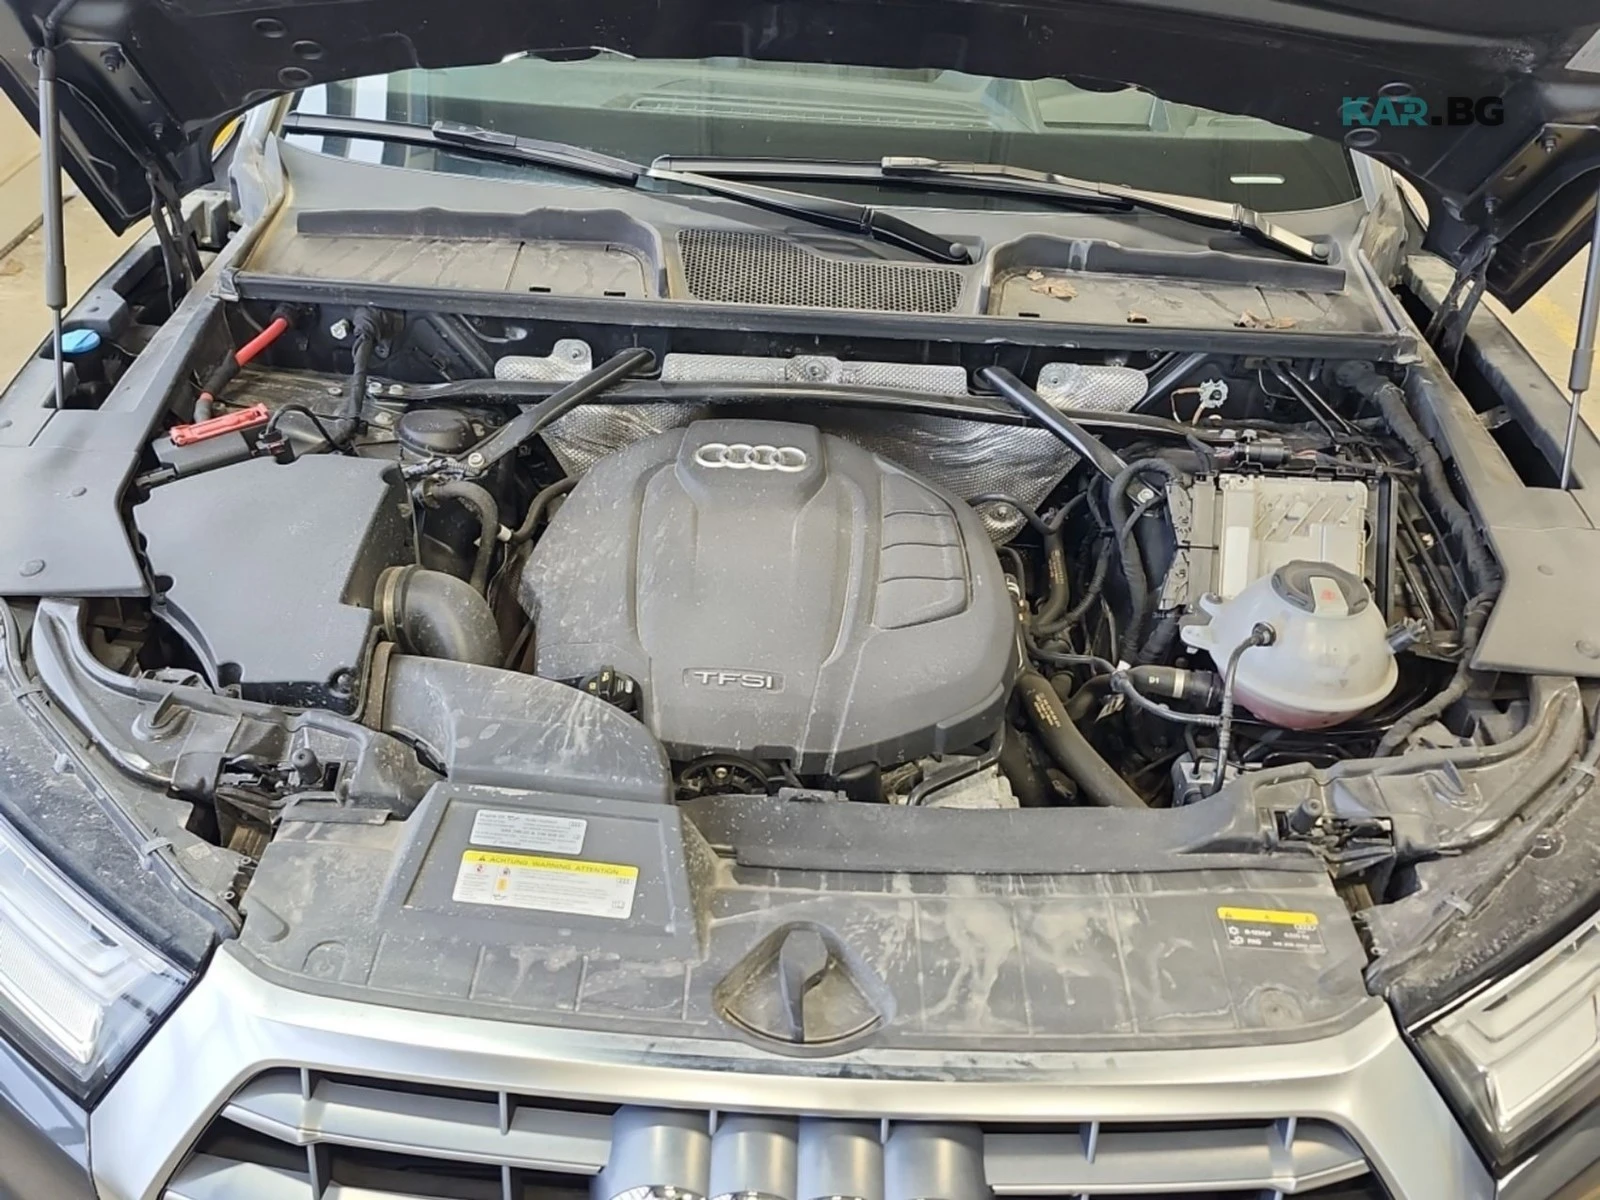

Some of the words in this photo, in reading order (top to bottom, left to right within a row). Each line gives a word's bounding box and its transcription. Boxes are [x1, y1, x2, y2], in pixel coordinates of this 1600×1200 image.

[694, 671, 774, 690] TFSI
[489, 857, 529, 867] ACHTUNG
[532, 860, 572, 871] WARNING
[574, 864, 620, 875] ATTENTION
